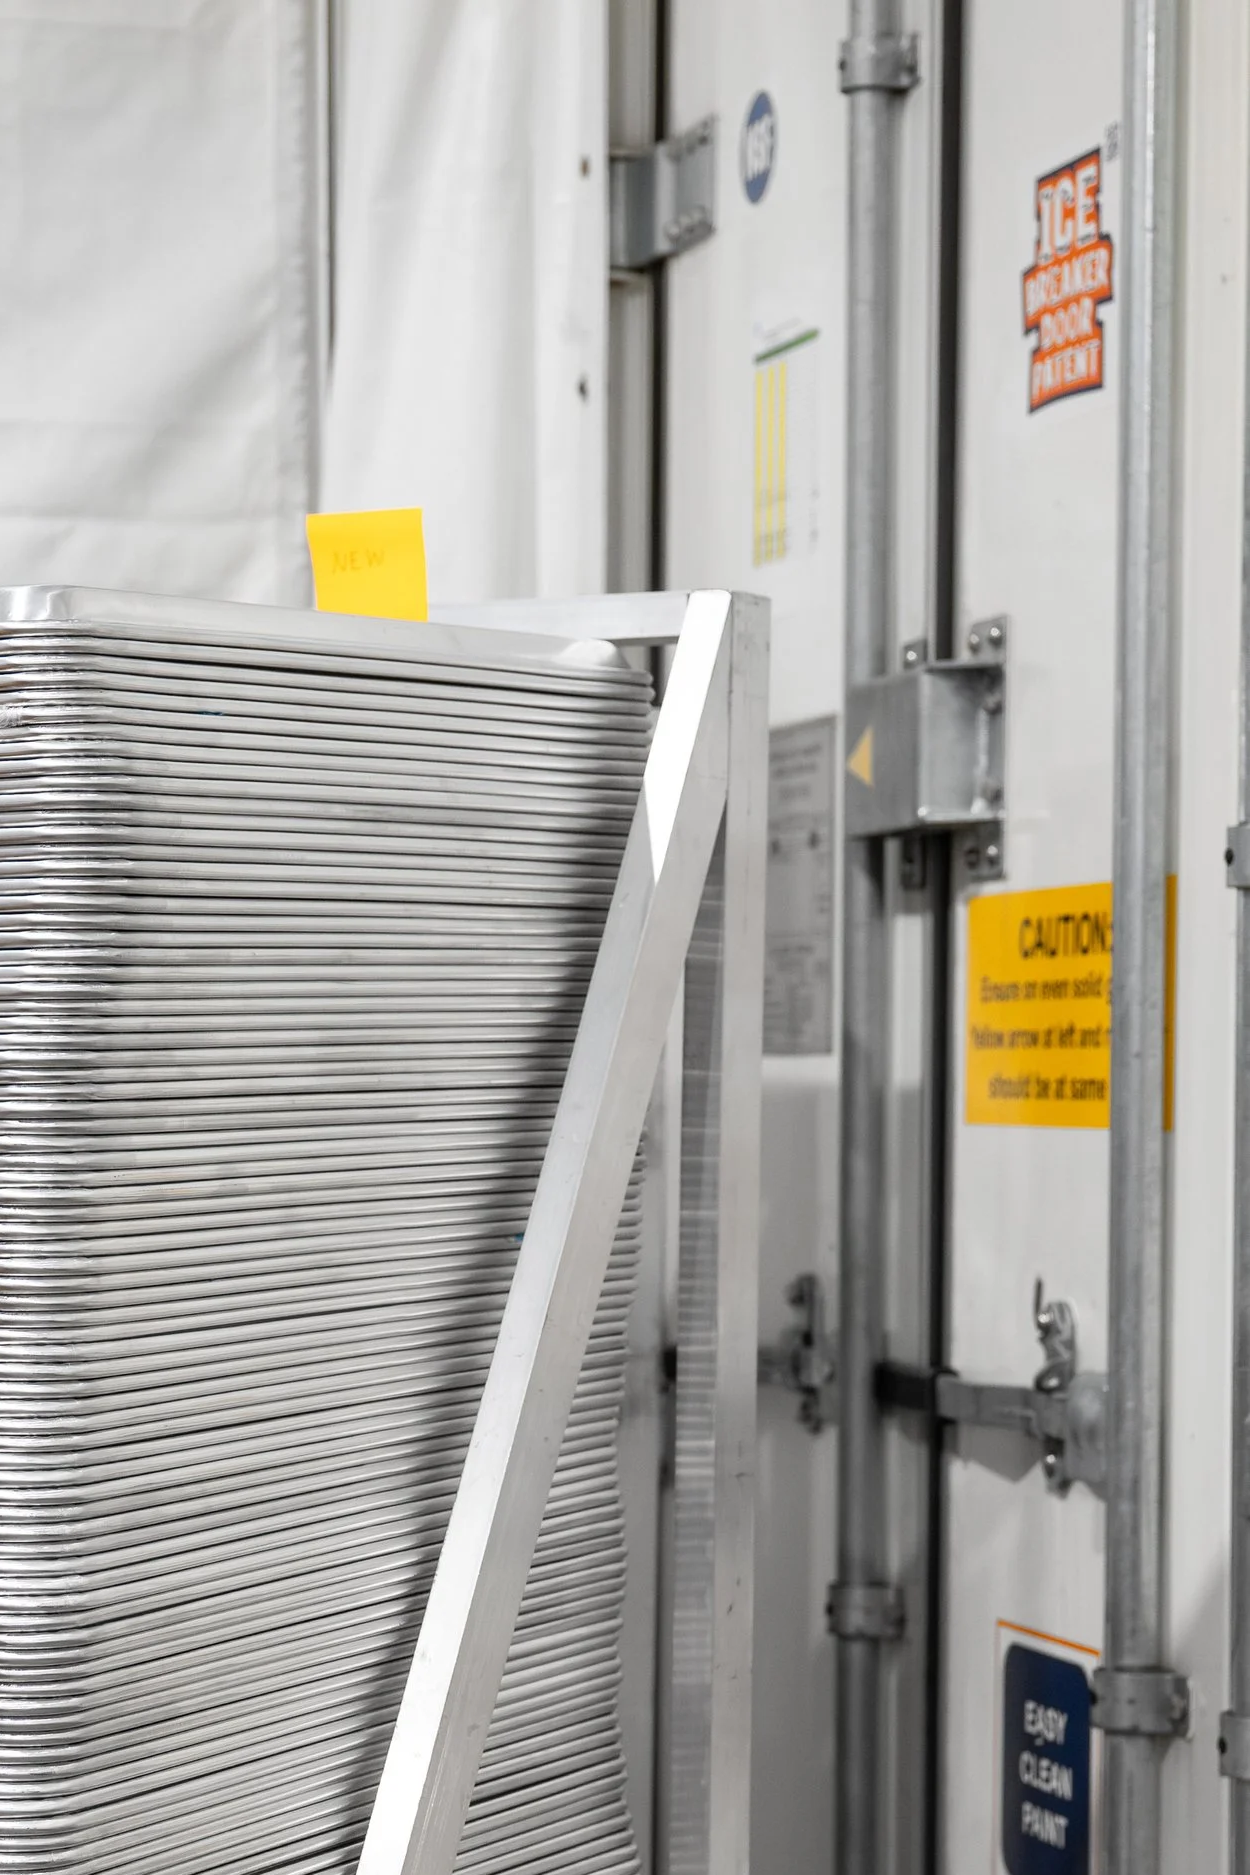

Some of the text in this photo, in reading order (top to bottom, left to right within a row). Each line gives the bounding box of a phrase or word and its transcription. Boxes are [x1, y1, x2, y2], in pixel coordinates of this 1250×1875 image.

[1039, 163, 1099, 263] ICE
[1025, 247, 1110, 316] BREAKER
[1040, 297, 1094, 350] DOOR
[1032, 338, 1101, 401] PATENT
[331, 547, 386, 576] NEW
[1070, 1076, 1107, 1100] same
[1023, 1699, 1069, 1745] EASY
[1018, 1750, 1073, 1801] CLEAN
[1021, 1800, 1069, 1849] PAINT
